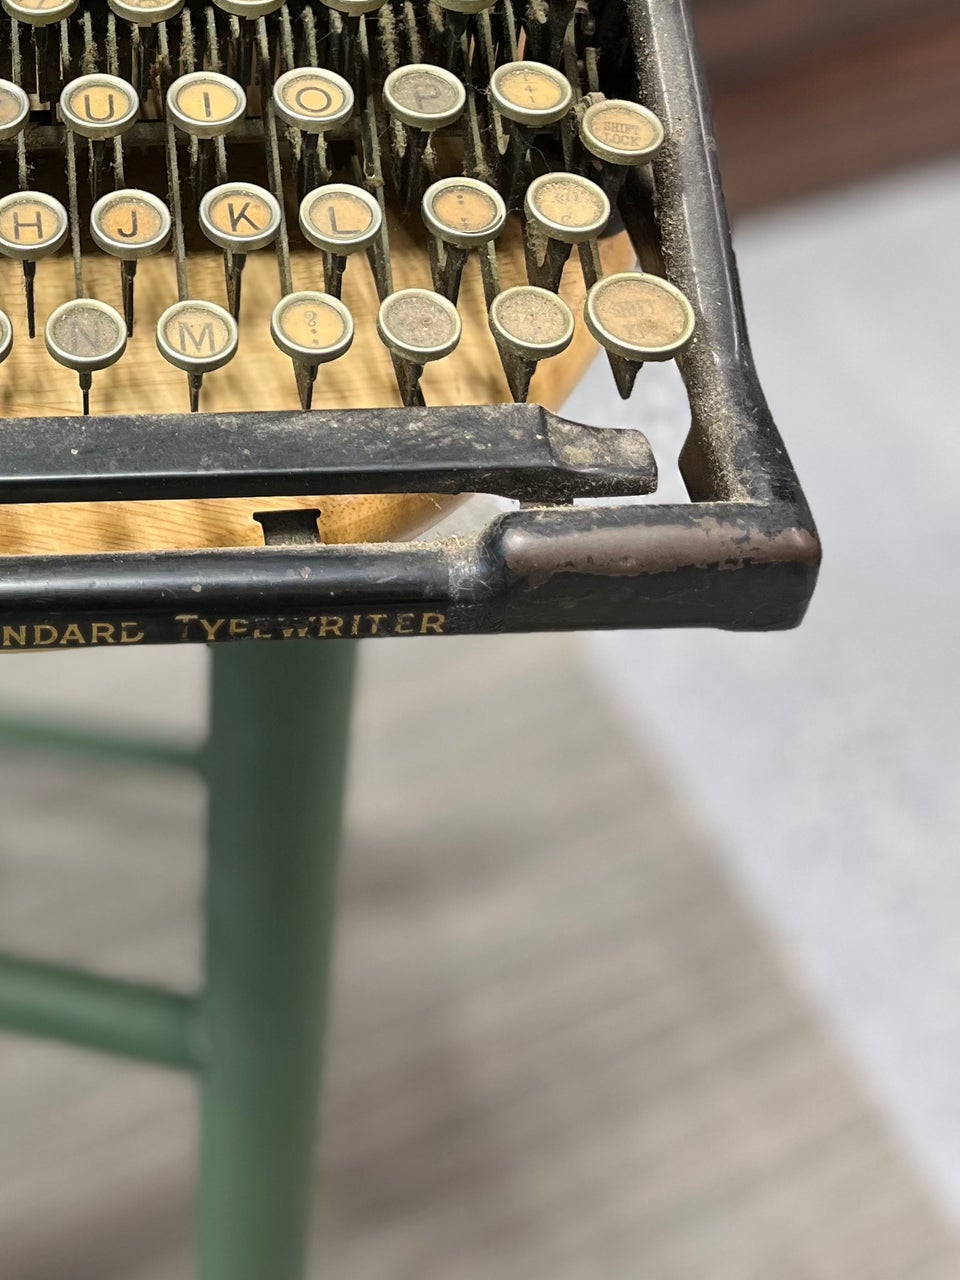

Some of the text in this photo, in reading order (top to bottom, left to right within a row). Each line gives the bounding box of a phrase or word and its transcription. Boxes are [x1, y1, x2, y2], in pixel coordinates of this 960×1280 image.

[83, 93, 114, 121] U
[295, 86, 332, 113] O
[414, 84, 440, 111] P
[603, 121, 641, 135] SHIFT
[604, 131, 642, 147] LOCK
[13, 210, 44, 241] H
[116, 209, 138, 238] J
[227, 201, 262, 233] K
[328, 206, 361, 236] L
[69, 320, 101, 352] N
[177, 320, 216, 354] M
